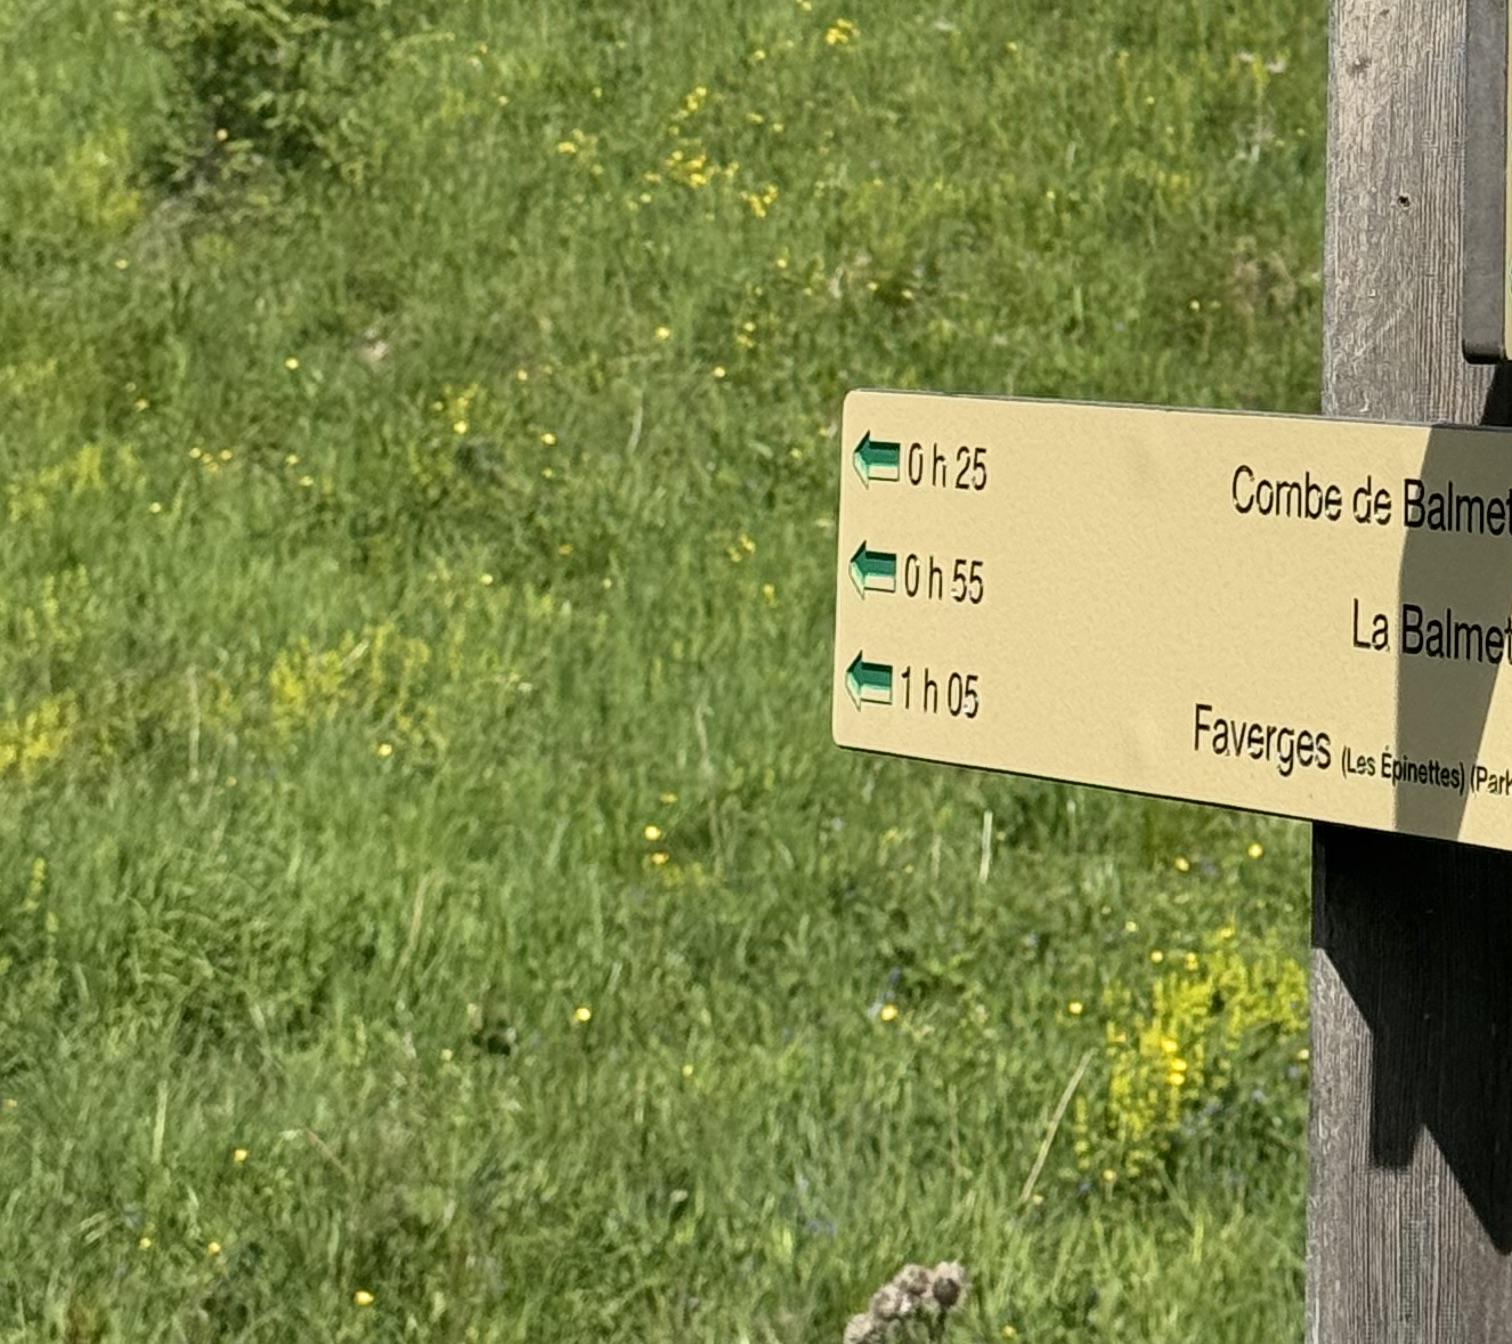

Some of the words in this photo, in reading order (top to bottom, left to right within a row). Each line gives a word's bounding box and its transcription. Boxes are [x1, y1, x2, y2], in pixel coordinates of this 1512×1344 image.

[907, 442, 924, 486] 0
[931, 443, 947, 488] h
[954, 446, 988, 491] 25
[1231, 464, 1343, 521] Combe
[1352, 475, 1393, 526] de
[904, 553, 920, 599] 0
[927, 556, 944, 601] h
[950, 558, 985, 604] 55
[1352, 598, 1391, 652] La
[901, 666, 912, 710] 1
[923, 667, 939, 713] h
[946, 672, 980, 719] 05
[1194, 702, 1332, 777] Faverges
[1341, 745, 1376, 777] (Les
[1381, 745, 1466, 796] Épinettes)
